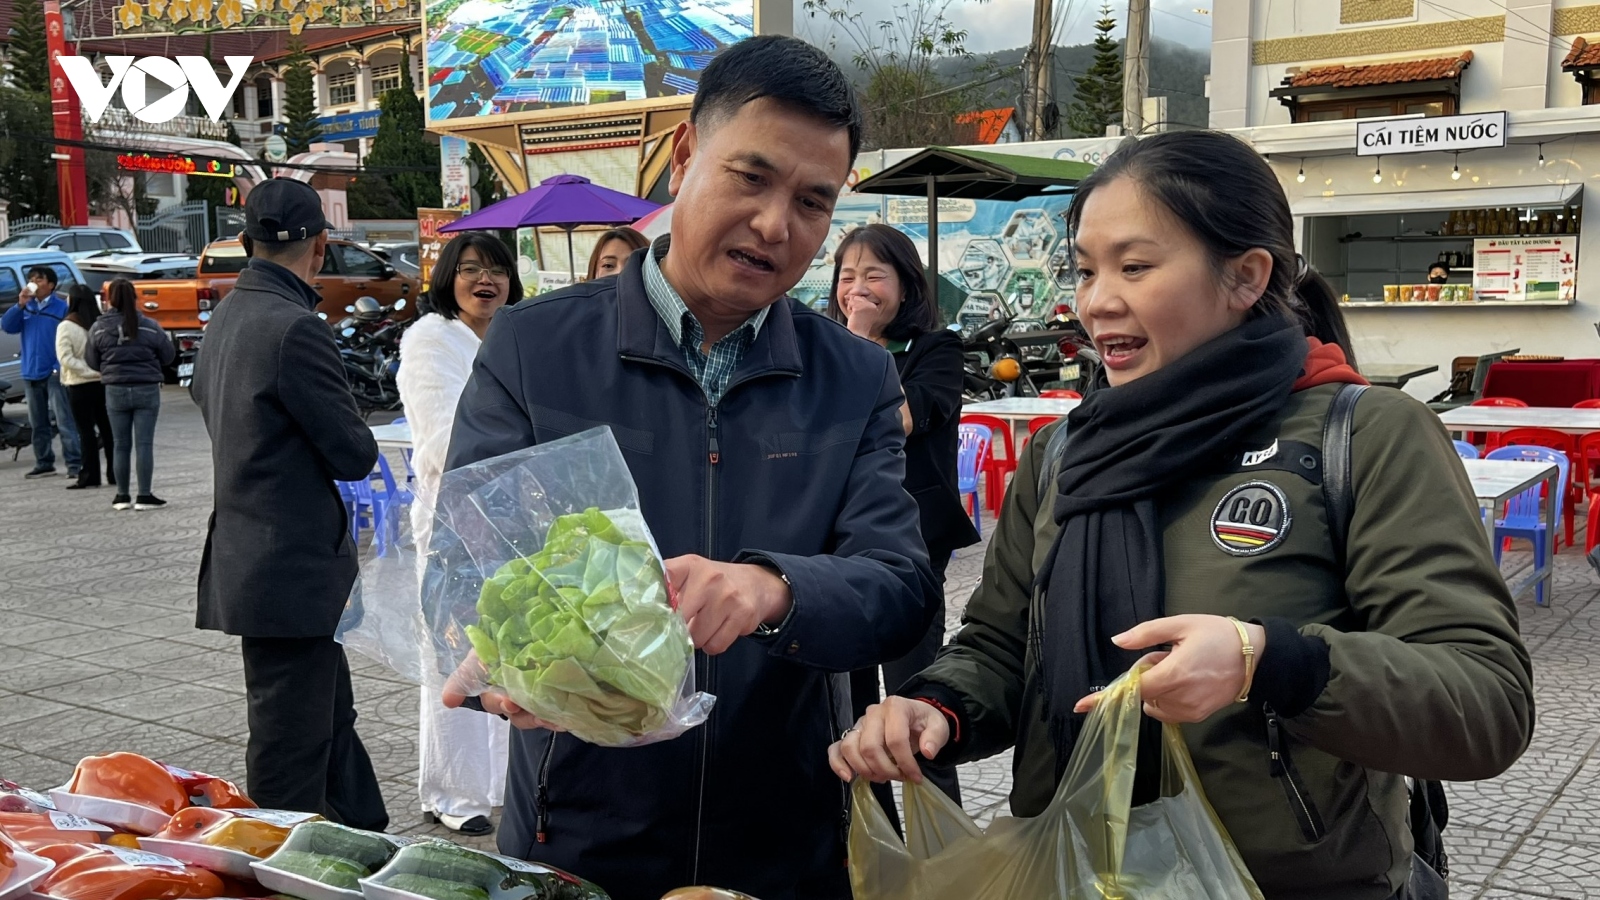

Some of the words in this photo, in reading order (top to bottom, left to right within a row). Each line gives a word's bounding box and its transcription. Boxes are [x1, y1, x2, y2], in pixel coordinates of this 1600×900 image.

[1363, 127, 1392, 147] CÁI
[1399, 125, 1439, 146] TIỆM
[1446, 118, 1498, 141] NƯỚC
[422, 243, 430, 258] 7
[1229, 496, 1272, 526] GO
